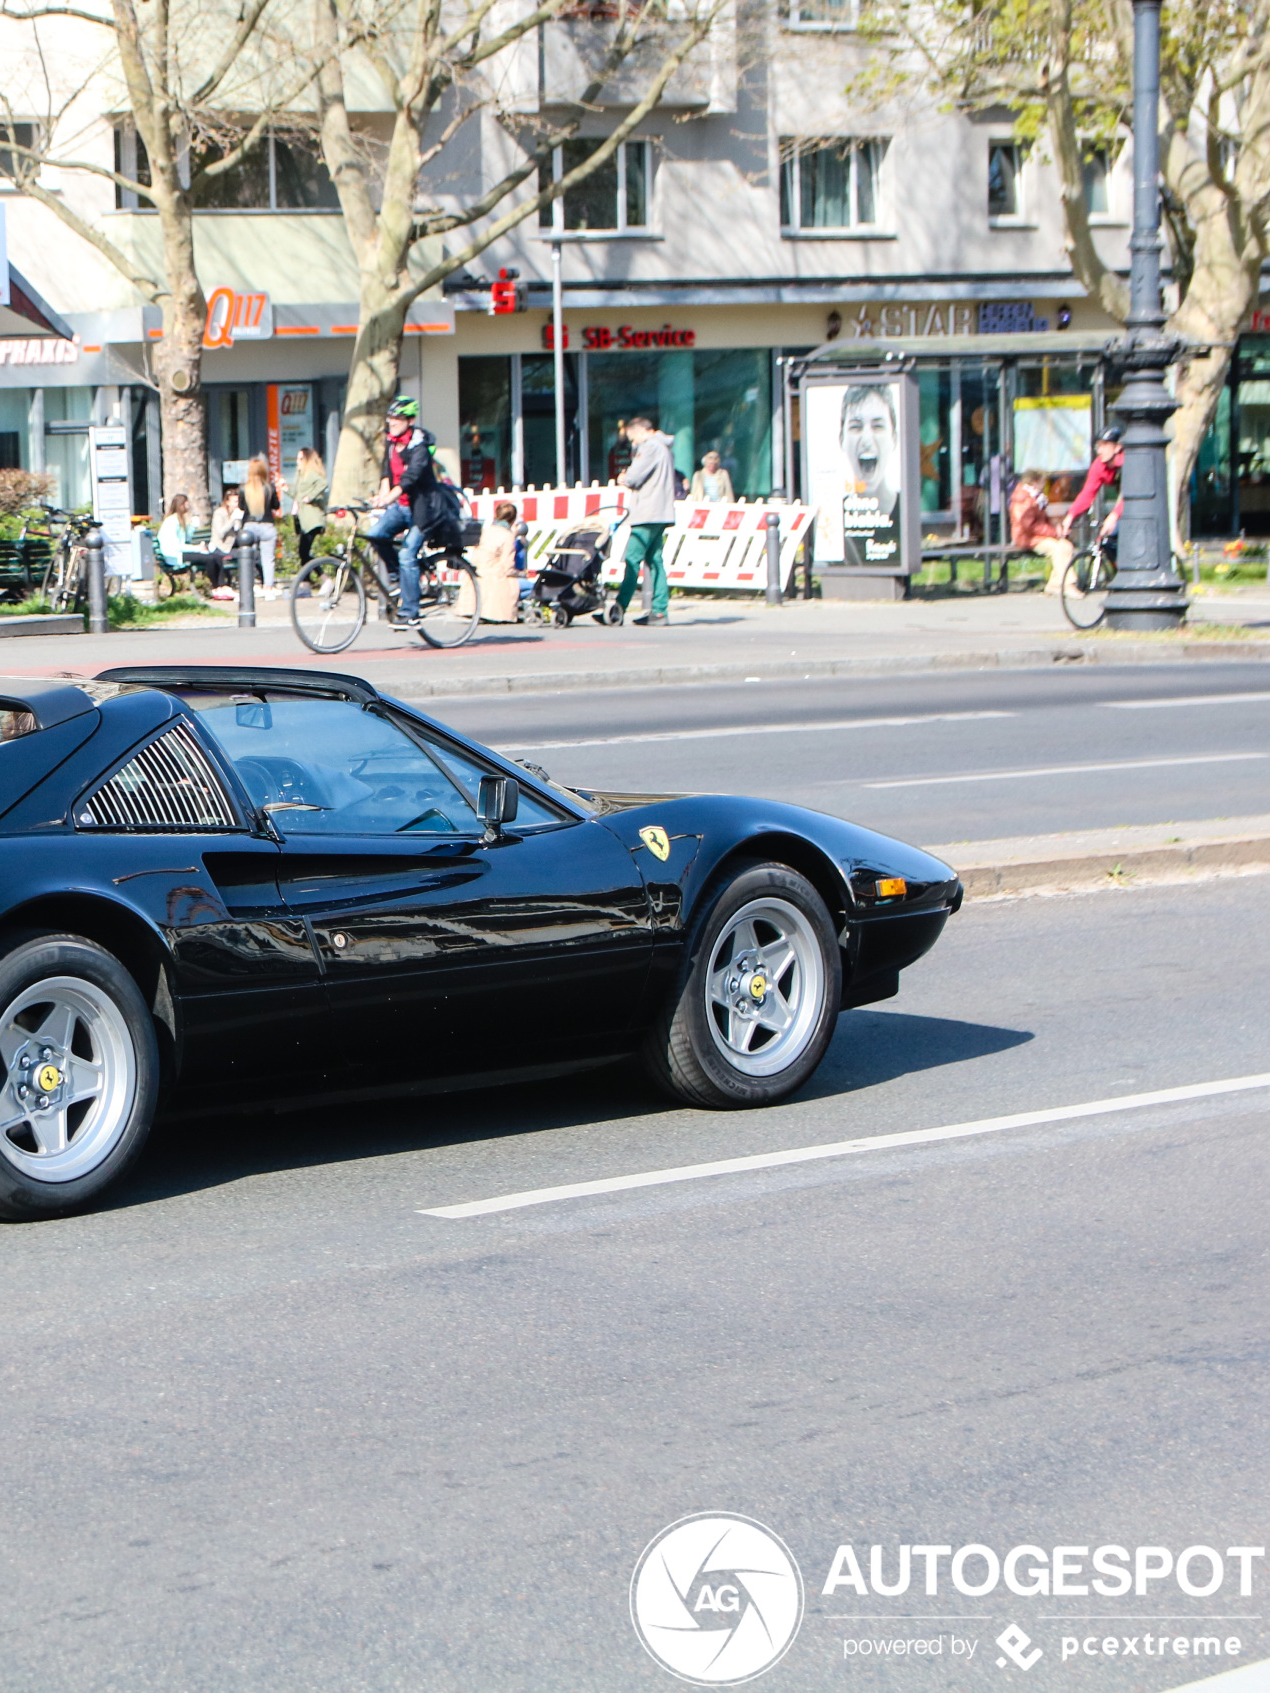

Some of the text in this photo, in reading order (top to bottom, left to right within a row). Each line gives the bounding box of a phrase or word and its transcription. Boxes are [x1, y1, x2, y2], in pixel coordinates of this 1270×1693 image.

[202, 288, 266, 348] Q117
[880, 304, 973, 337] STAR
[583, 324, 696, 349] SB-Service
